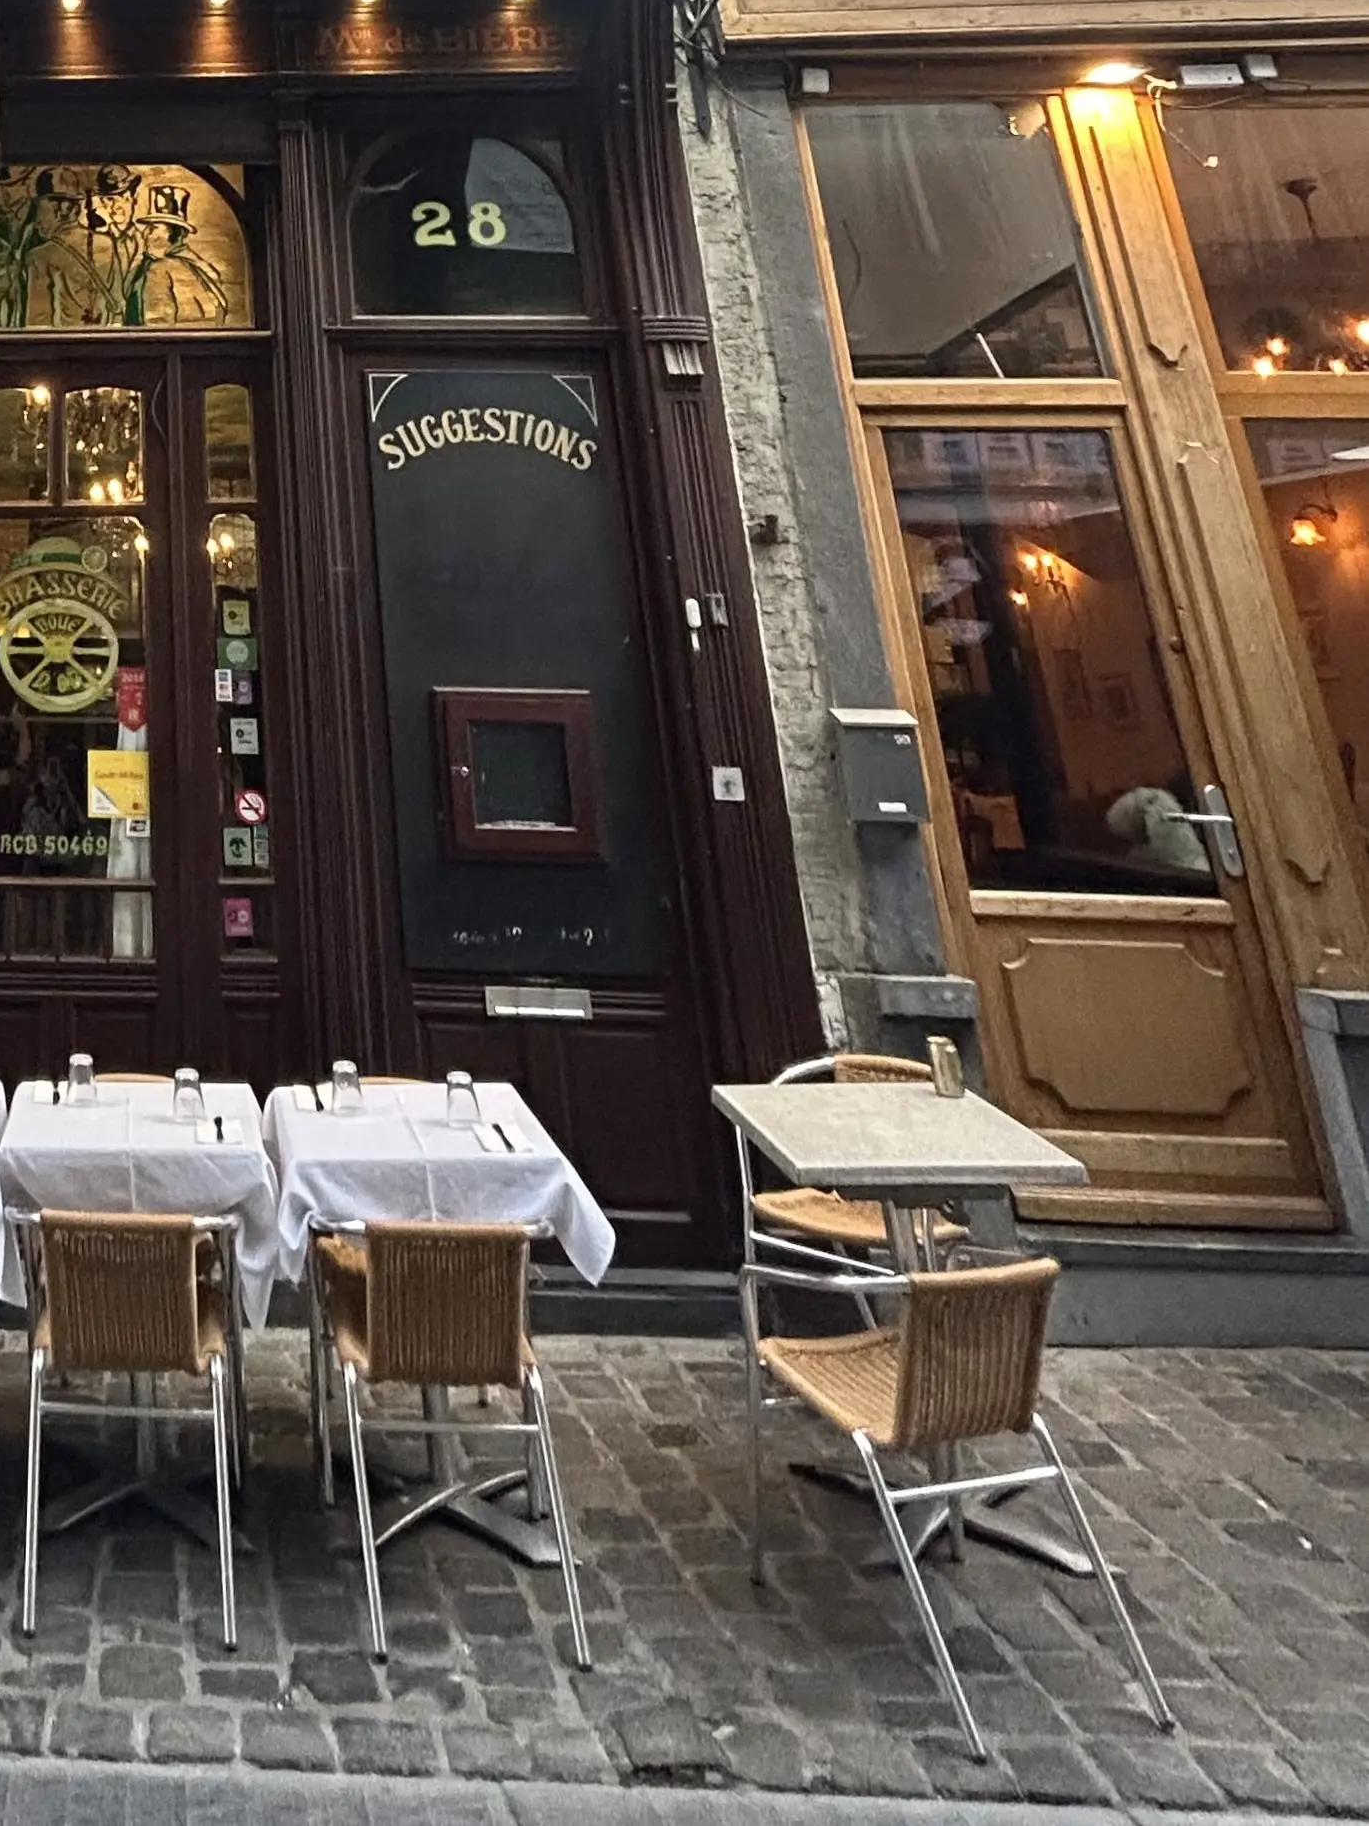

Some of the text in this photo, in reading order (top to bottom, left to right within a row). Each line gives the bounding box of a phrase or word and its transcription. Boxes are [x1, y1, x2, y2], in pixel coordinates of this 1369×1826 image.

[411, 201, 507, 247] 28
[379, 407, 598, 471] SUGGESTIONS
[0, 833, 38, 855] RCB
